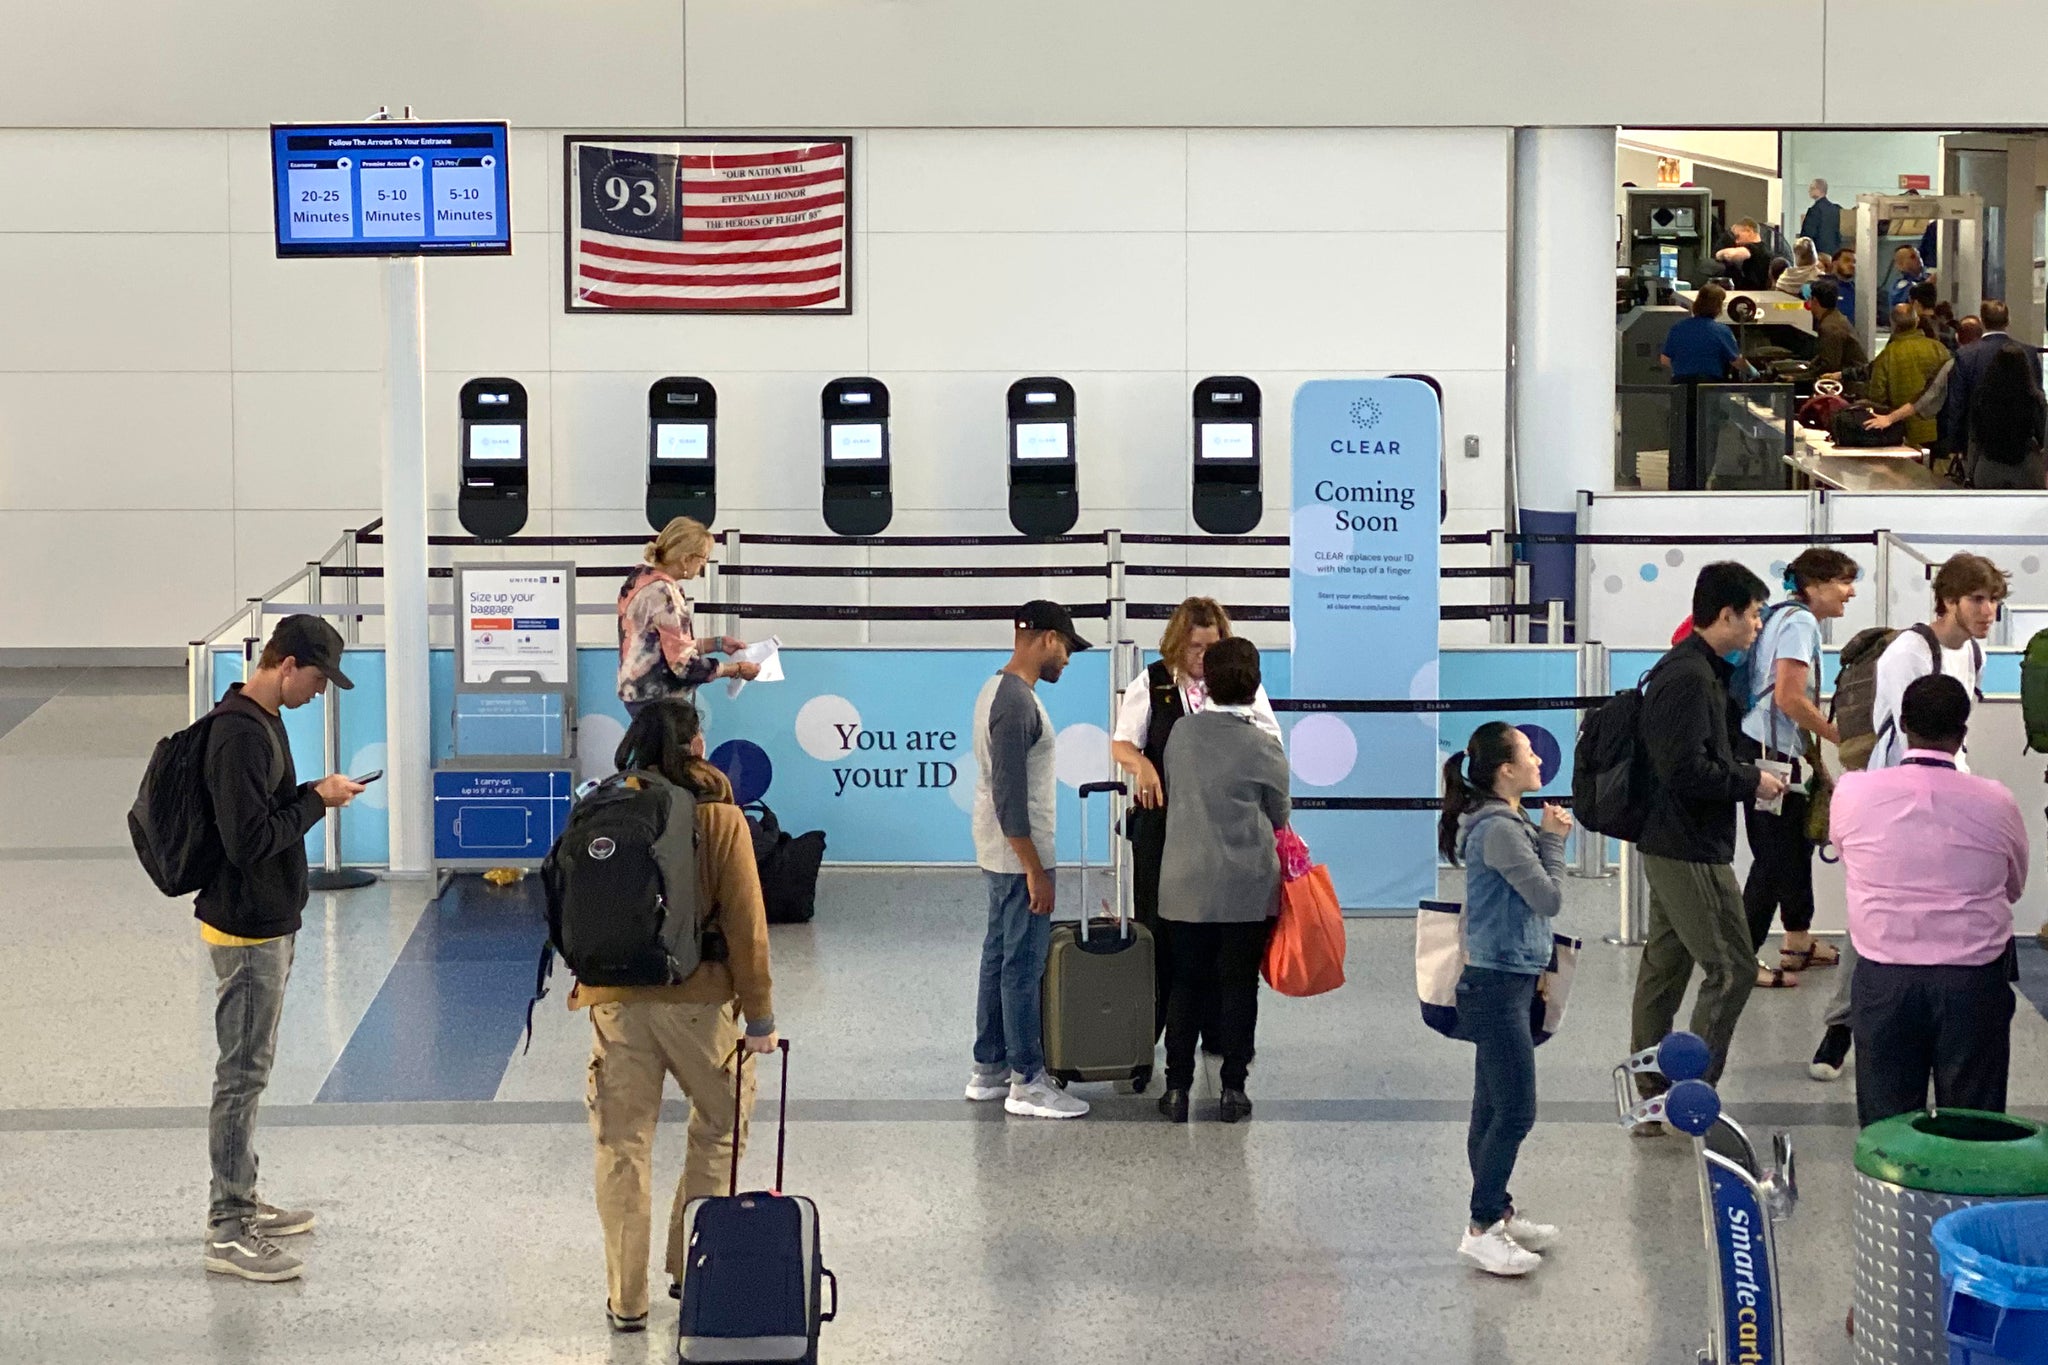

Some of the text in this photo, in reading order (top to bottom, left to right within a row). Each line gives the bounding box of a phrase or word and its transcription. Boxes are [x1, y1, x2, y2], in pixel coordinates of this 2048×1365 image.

[328, 137, 452, 146] Follow The Arrows To Your Entrance
[748, 165, 782, 177] NATION
[783, 164, 805, 174] WILL
[301, 190, 340, 202] 20-25
[377, 189, 407, 201] 5-10
[449, 188, 479, 200] 5-10
[605, 177, 657, 216] 93
[721, 188, 806, 203] ETERNALLY HONOR
[293, 211, 350, 223] Minutes
[365, 210, 421, 222] Minutes
[437, 209, 493, 221] Minutes
[706, 220, 725, 229] THE
[725, 218, 760, 228] HEROES
[762, 216, 774, 225] OF
[776, 213, 806, 224] FLIGHT
[1330, 440, 1400, 455] CLEAR
[1315, 480, 1415, 510] Coming
[1335, 510, 1399, 532] Soon
[1314, 551, 1414, 562] CLEAR replaces your ID
[1317, 565, 1336, 573] with
[1353, 566, 1367, 575] tap
[1369, 566, 1378, 574] of
[1387, 566, 1411, 576] finger
[470, 592, 535, 603] Size up your
[470, 604, 514, 615] baggage
[833, 723, 957, 751] You are
[474, 777, 512, 786] 1 carry-on
[832, 761, 958, 797] your ID
[1728, 1206, 1763, 1365] smartecart
